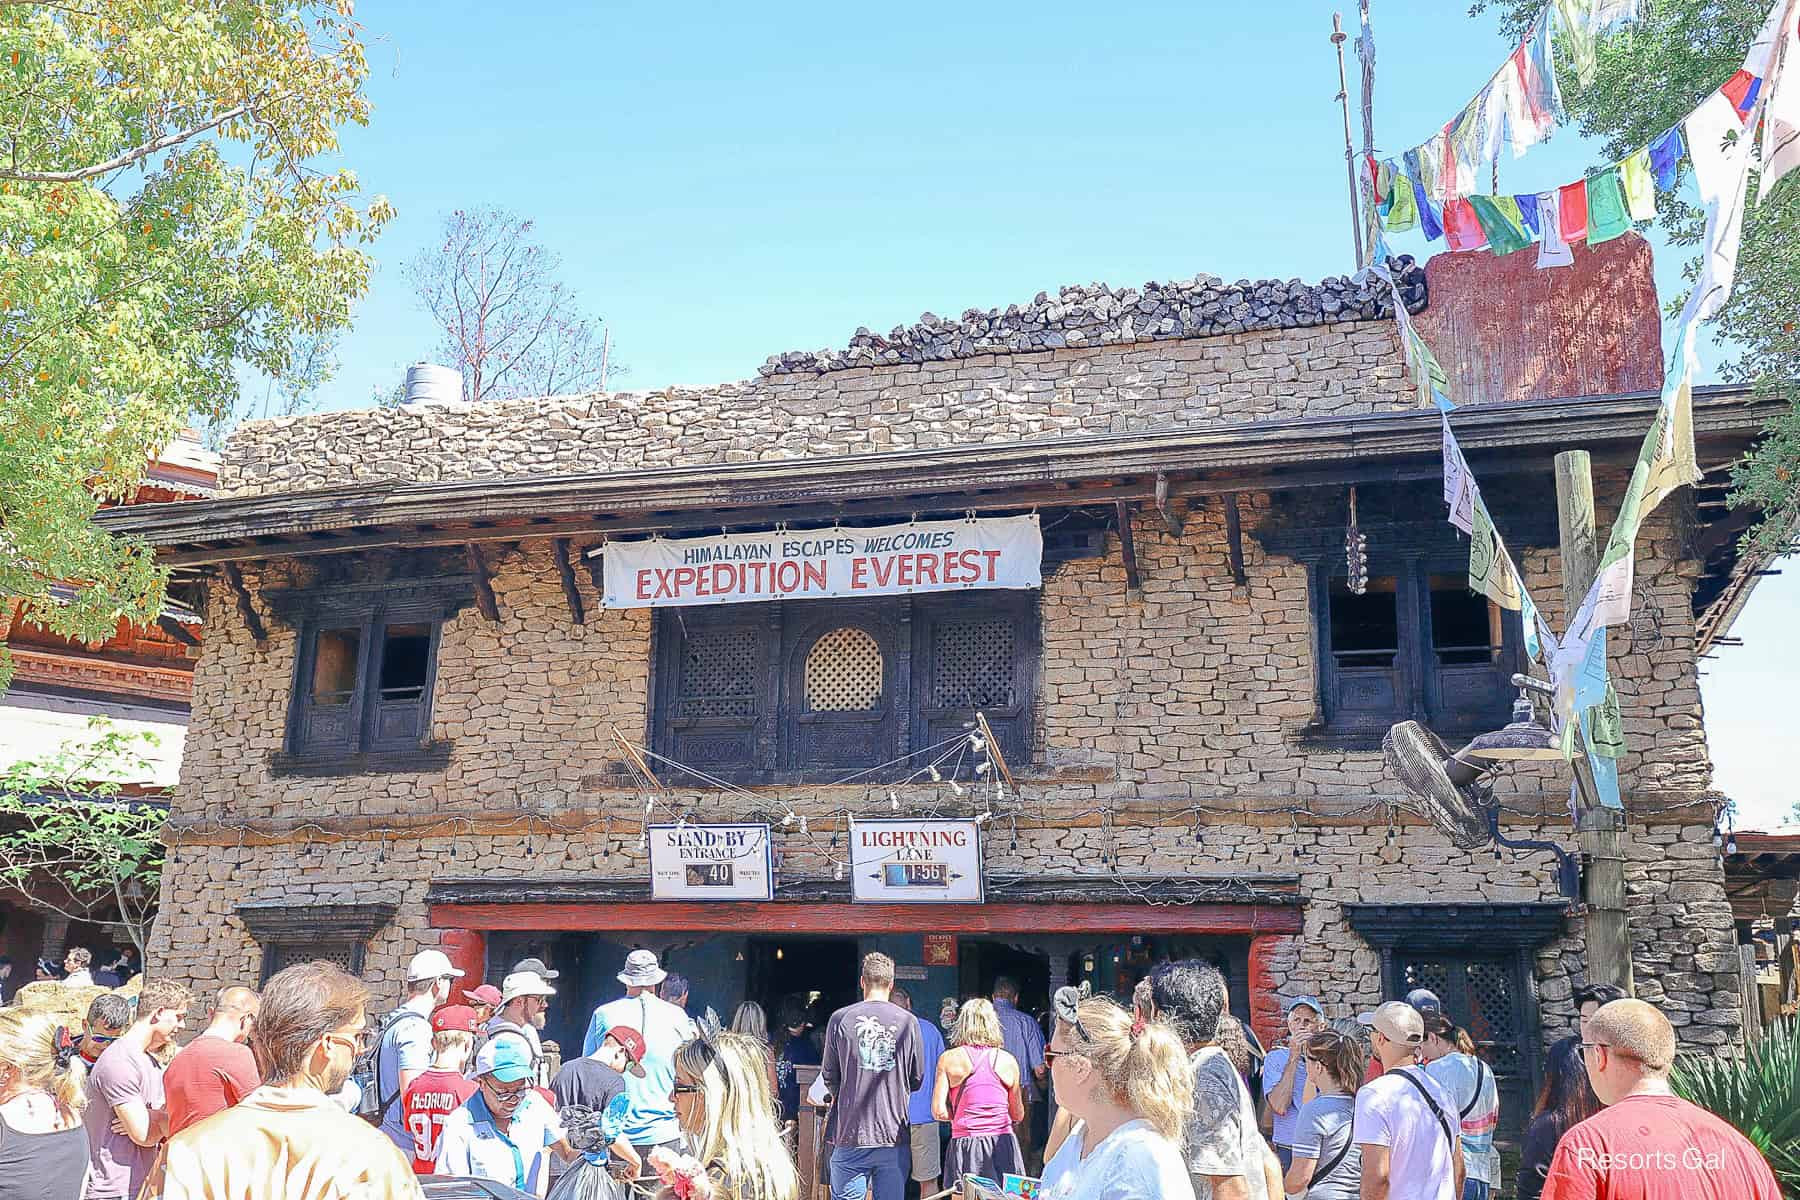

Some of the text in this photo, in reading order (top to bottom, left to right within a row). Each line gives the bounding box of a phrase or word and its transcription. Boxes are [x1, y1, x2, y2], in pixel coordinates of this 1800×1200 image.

[684, 531, 954, 564] HIMALAYAN ESCAPES WELCOMES
[636, 549, 1001, 599] EXPEDITION EVEREST
[861, 831, 966, 847] LIGHTNING
[680, 848, 737, 859] ENTRANCE
[897, 849, 933, 861] LANE
[709, 864, 729, 881] 40
[411, 1092, 453, 1111] McDAVID
[409, 1113, 444, 1162] 97
